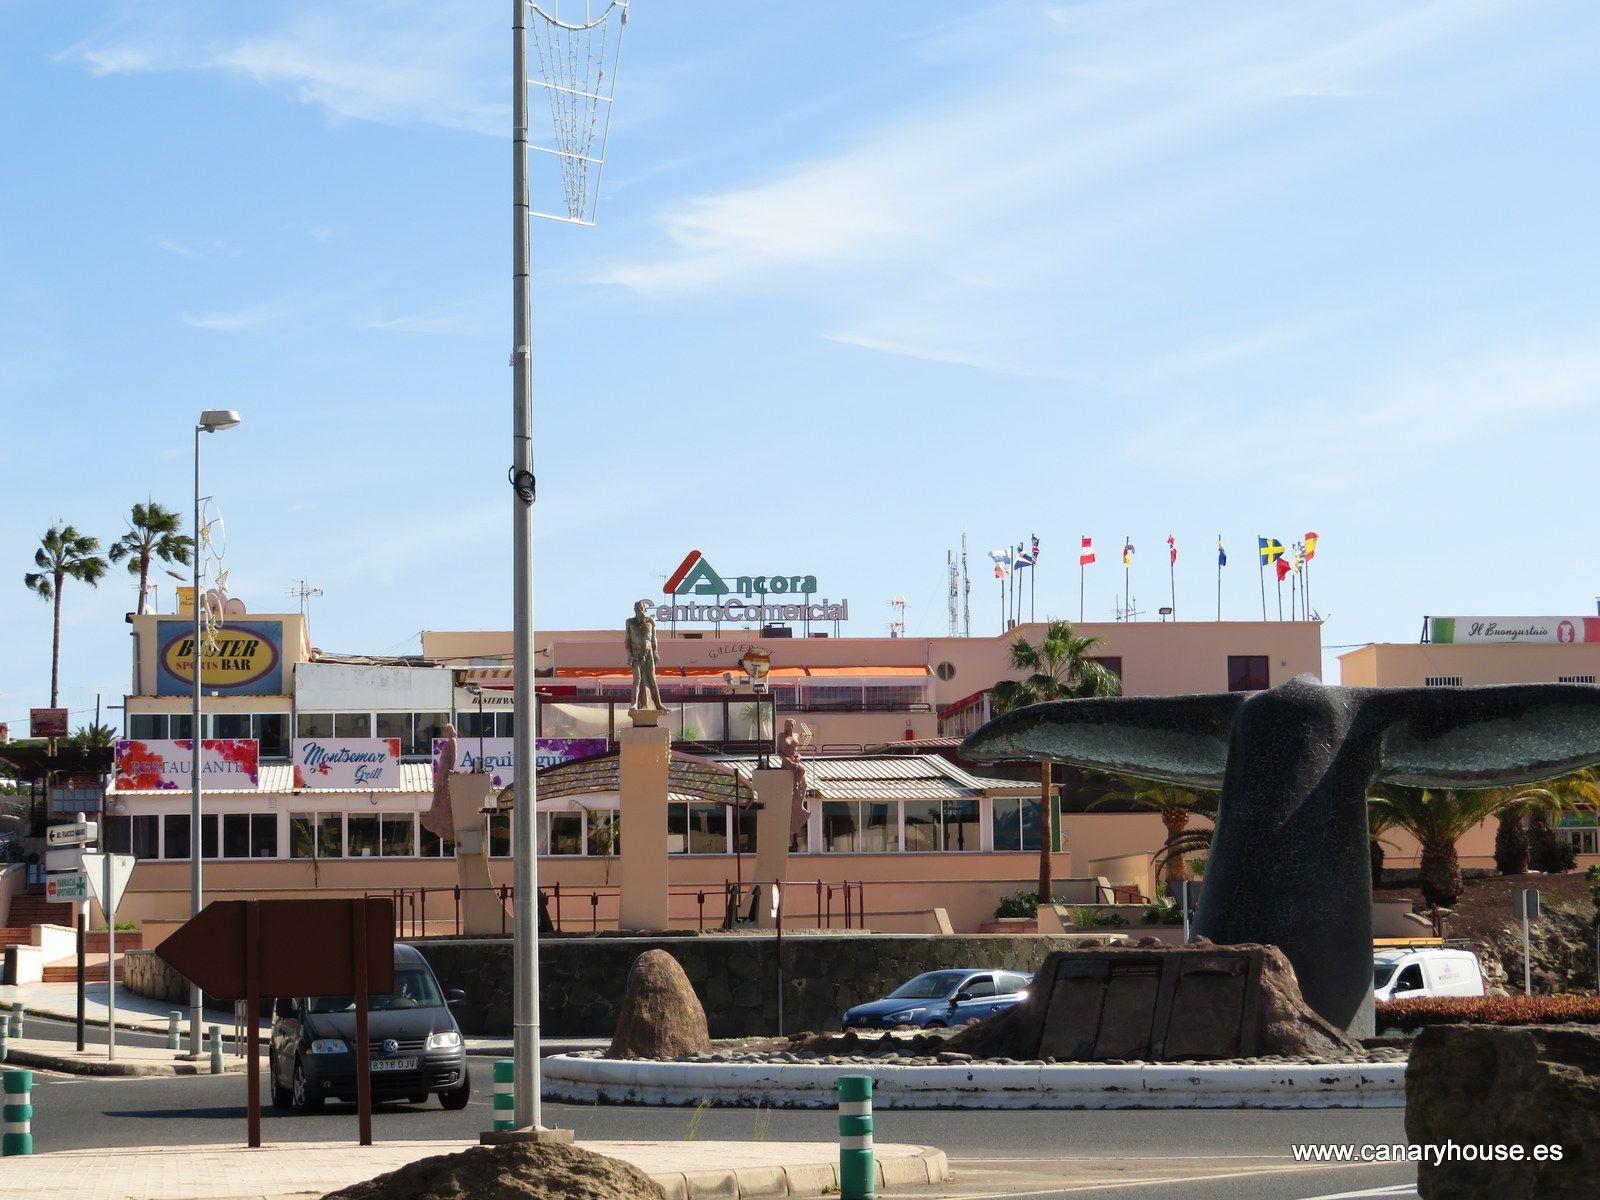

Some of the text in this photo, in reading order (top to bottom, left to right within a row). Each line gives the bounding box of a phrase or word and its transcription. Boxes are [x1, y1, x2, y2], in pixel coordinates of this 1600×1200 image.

[1468, 622, 1550, 641] Il Buongustaio
[221, 658, 251, 671] BAR
[302, 741, 388, 773] Montsemar
[459, 749, 575, 773] Arguiguín
[130, 760, 244, 774] RESTAUANTE
[354, 764, 383, 784] Grill
